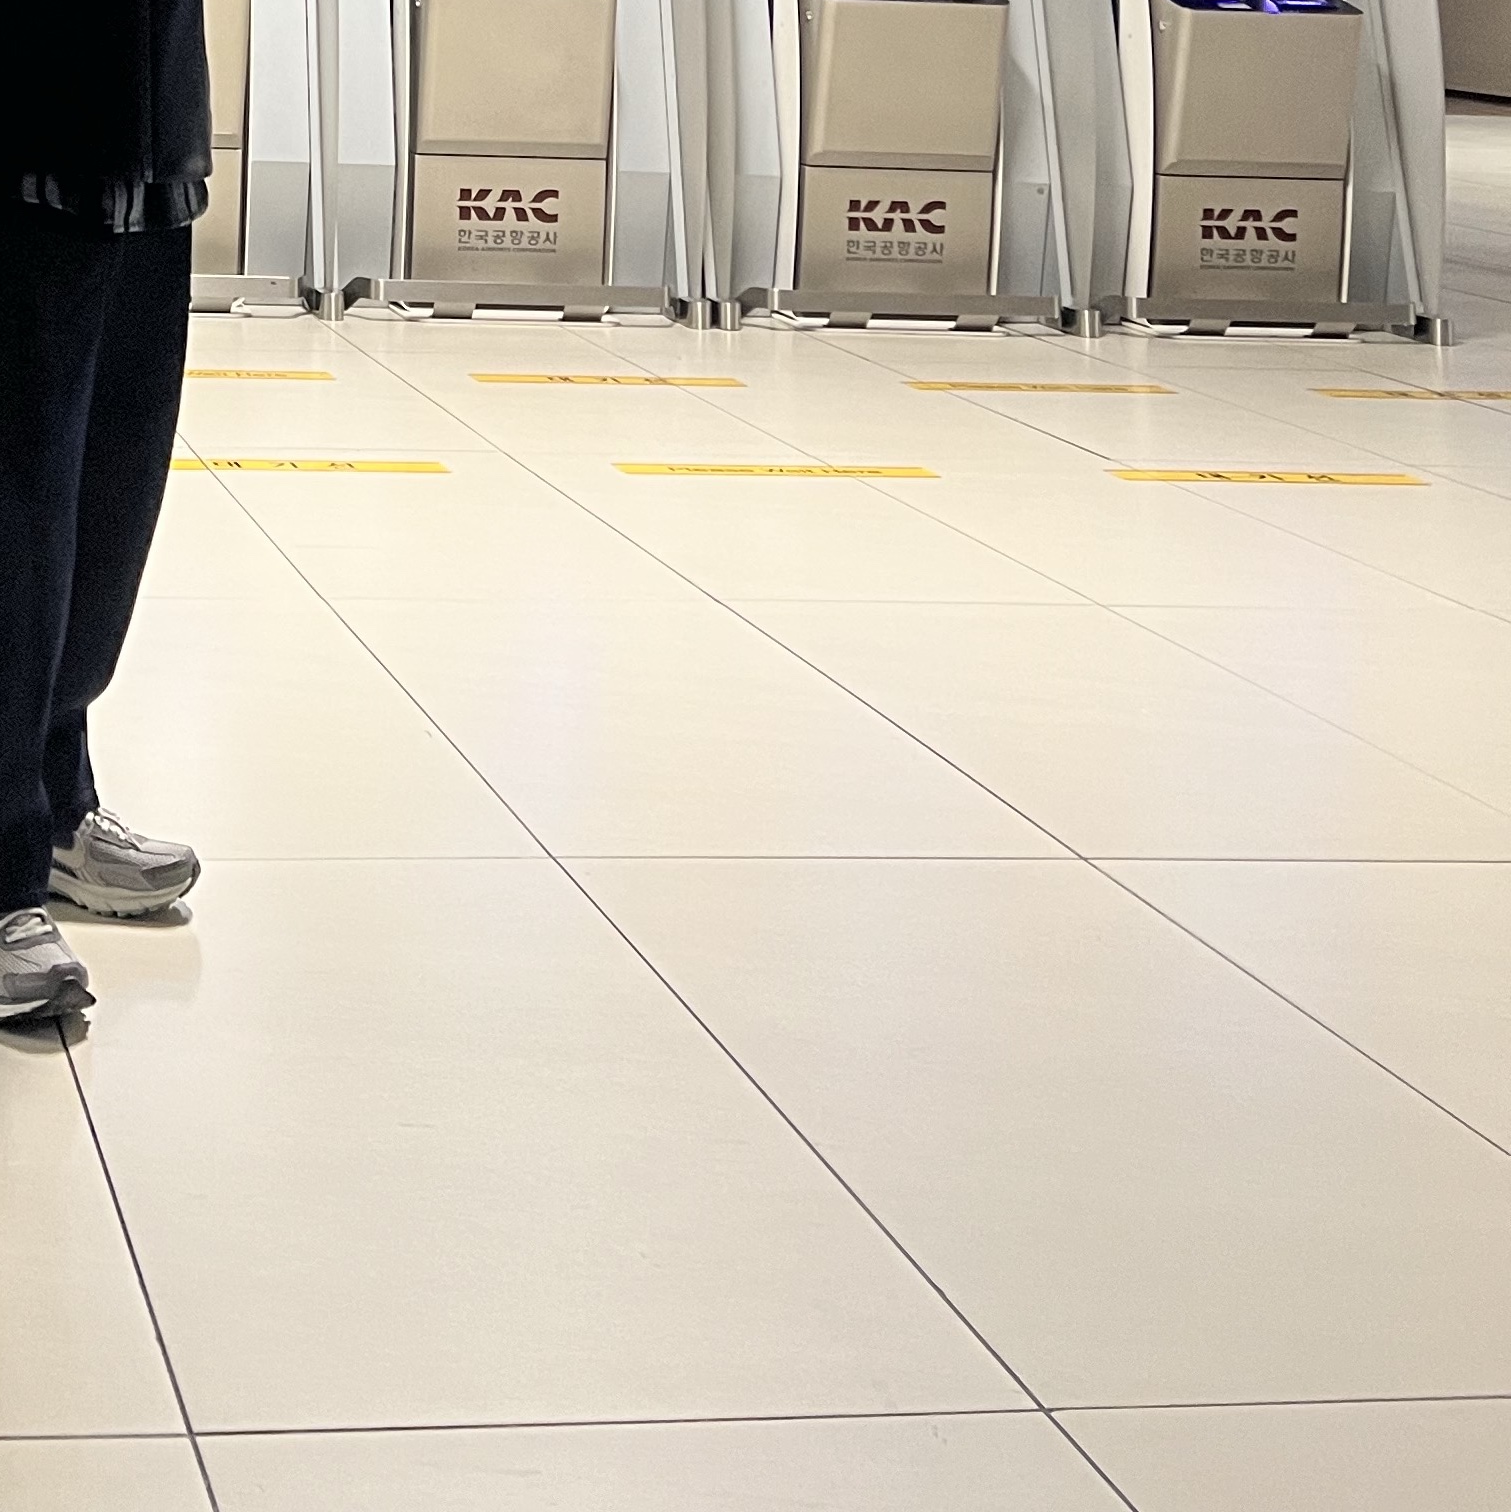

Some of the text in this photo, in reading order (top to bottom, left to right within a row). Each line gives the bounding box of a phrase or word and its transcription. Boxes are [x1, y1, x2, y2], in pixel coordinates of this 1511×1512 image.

[457, 188, 559, 224] KAC
[846, 199, 947, 235] KAC
[457, 229, 558, 246] 한국공항공사
[1199, 208, 1299, 243] KAC
[846, 239, 944, 257] 한국공항공사
[1199, 248, 1297, 264] 한국공항공사
